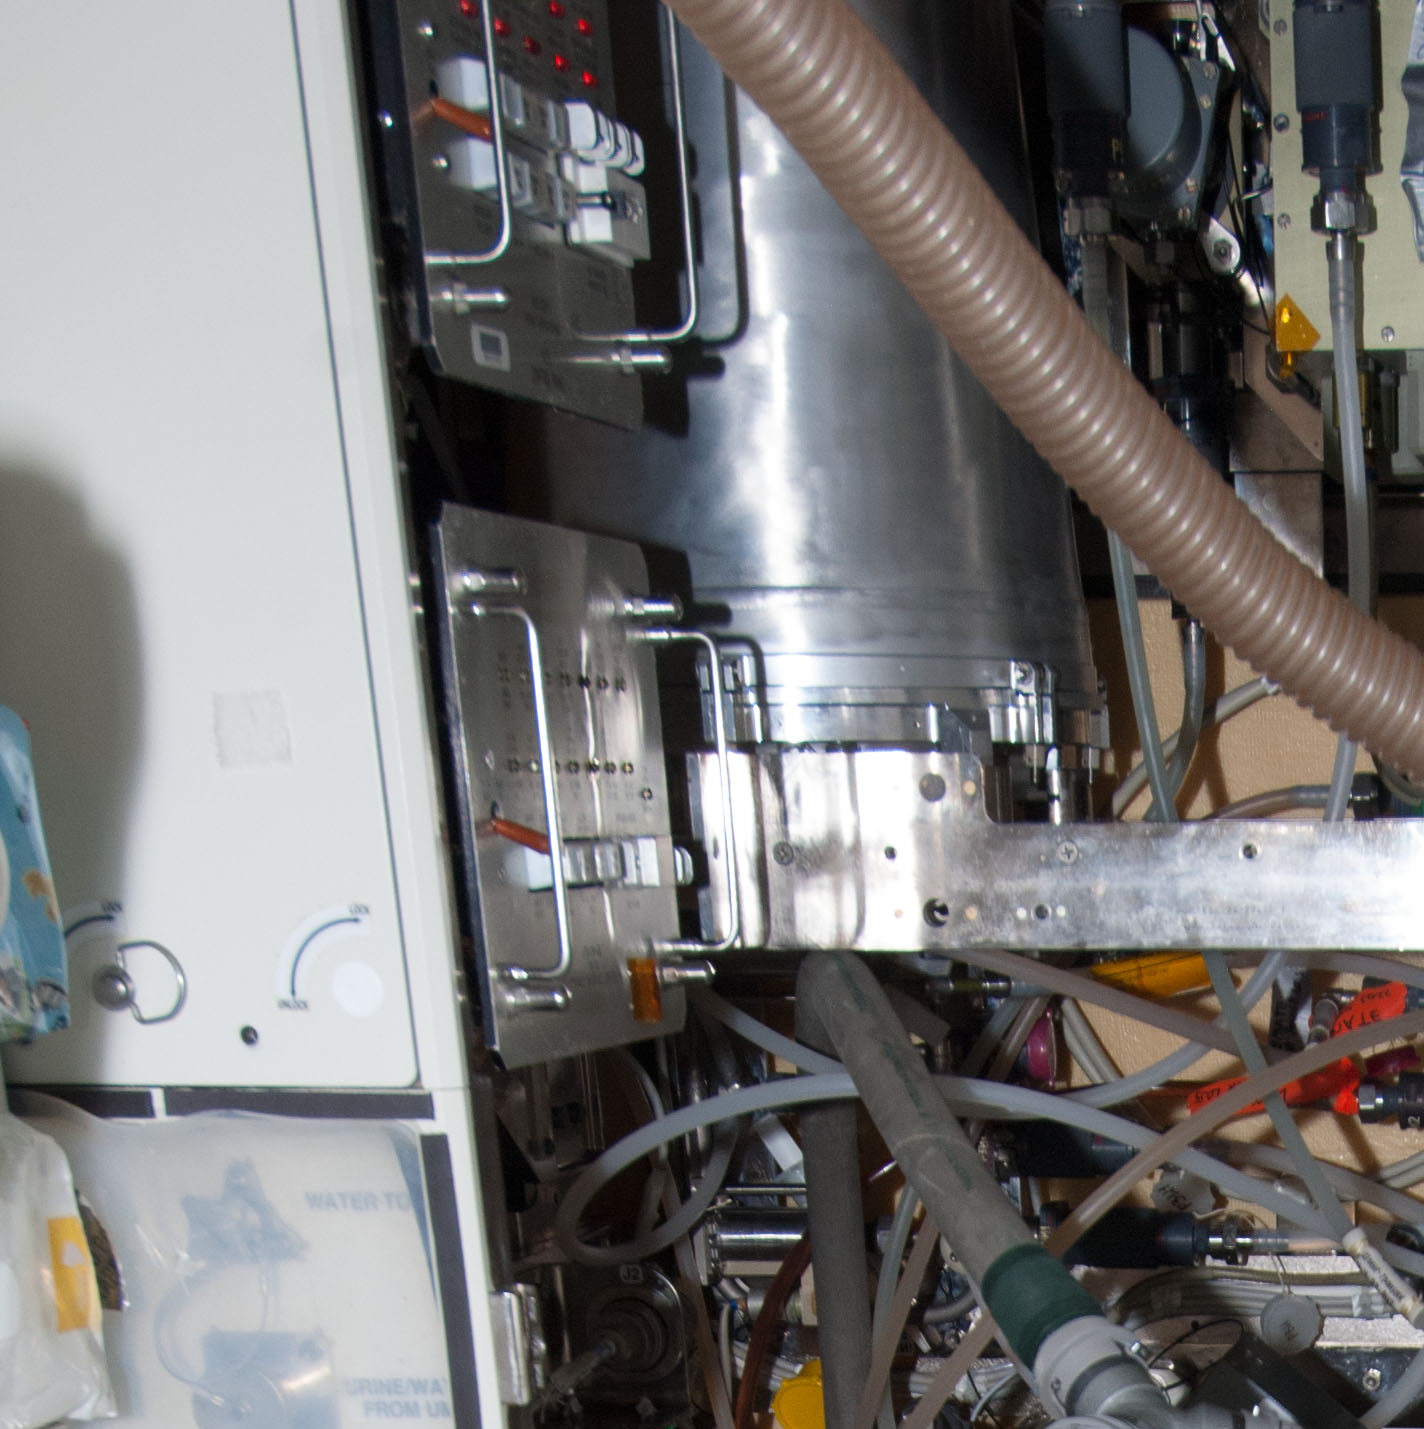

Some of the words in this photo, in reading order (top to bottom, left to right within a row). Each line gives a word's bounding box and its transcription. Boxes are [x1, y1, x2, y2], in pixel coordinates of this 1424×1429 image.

[305, 1191, 378, 1210] WATER
[623, 1266, 640, 1280] J2
[344, 1378, 447, 1396] URINE/WA
[363, 1400, 420, 1417] FROM
